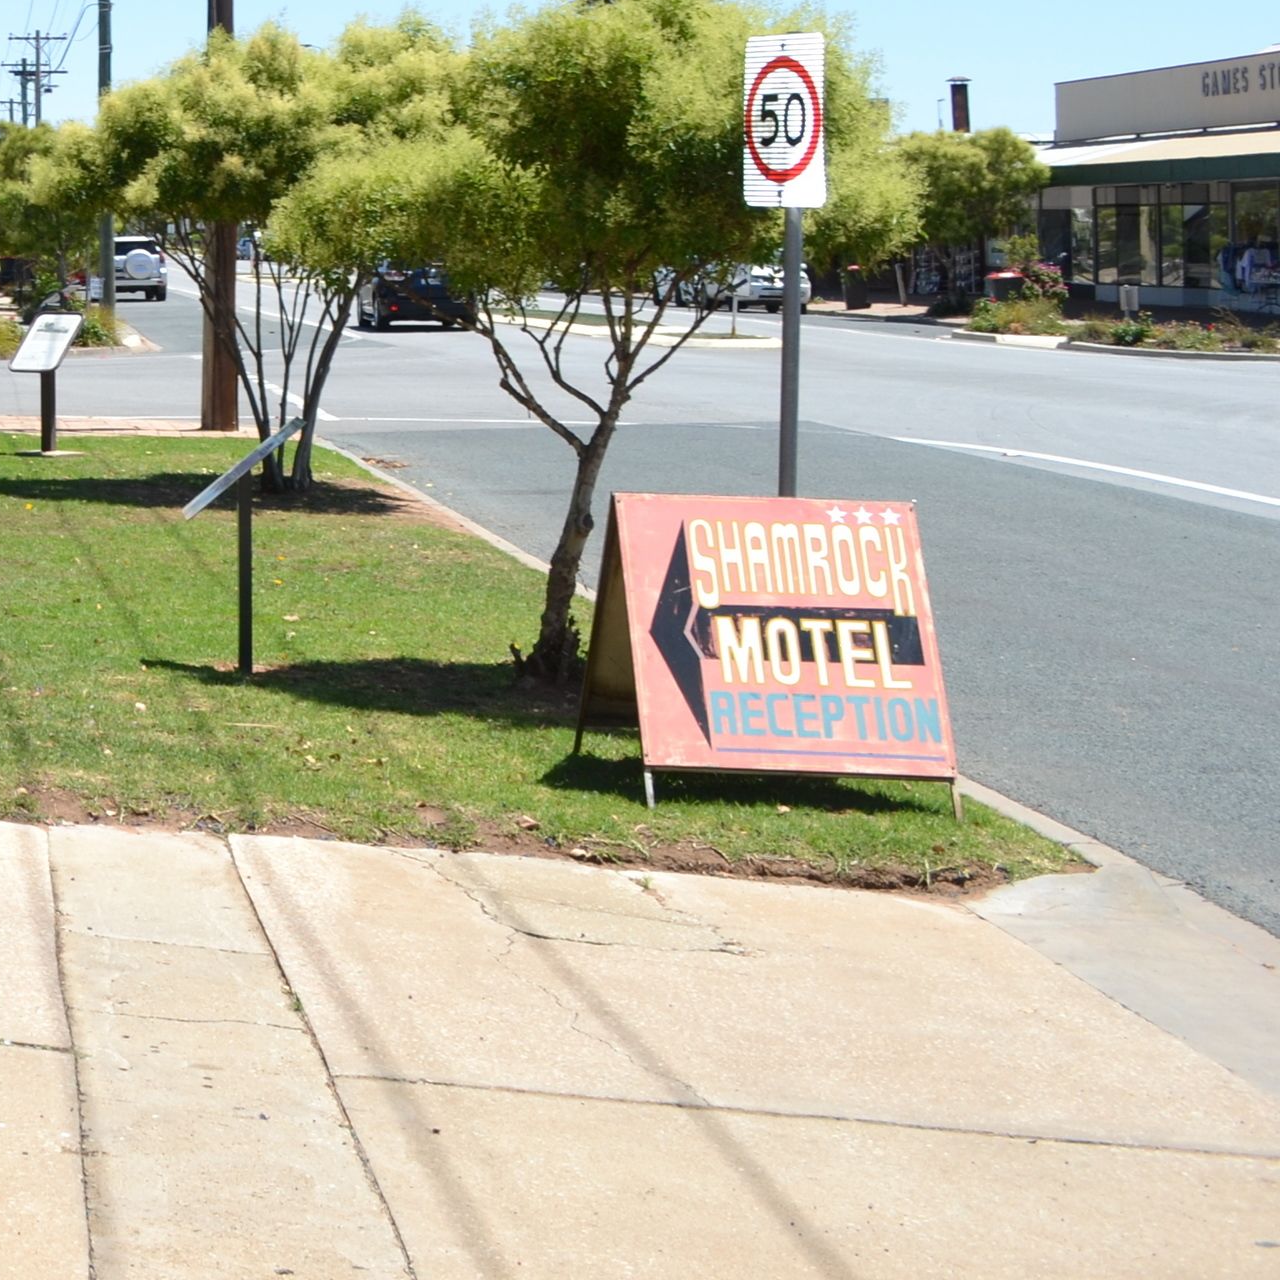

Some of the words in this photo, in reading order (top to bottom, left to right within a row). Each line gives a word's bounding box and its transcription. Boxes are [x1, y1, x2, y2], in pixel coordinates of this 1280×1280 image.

[1201, 66, 1248, 97] GAMES
[1258, 62, 1280, 91] ST
[759, 92, 806, 147] 50
[688, 518, 917, 616] SHAMROCK
[714, 615, 914, 689] MOTEL
[710, 690, 942, 744] RECEPTION
